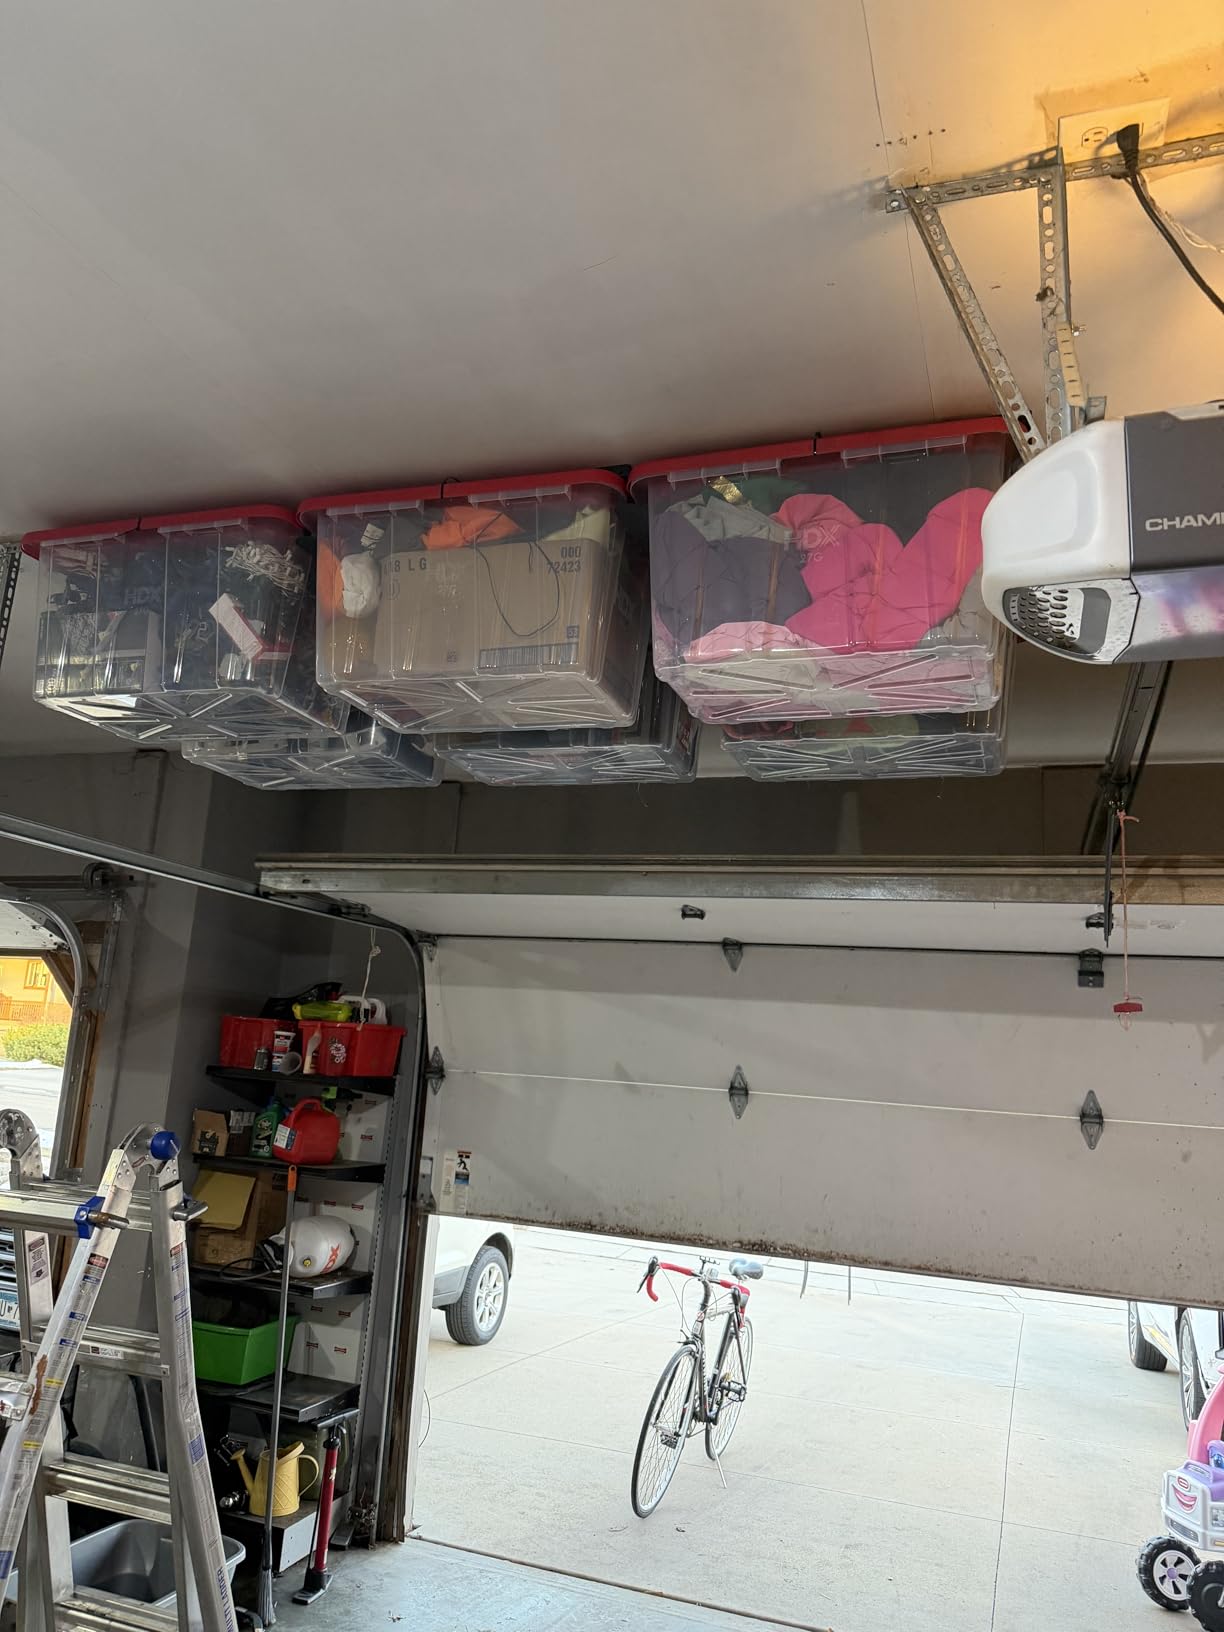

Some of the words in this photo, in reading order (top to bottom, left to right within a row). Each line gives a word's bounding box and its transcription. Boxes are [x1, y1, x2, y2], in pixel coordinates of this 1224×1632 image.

[1145, 512, 1224, 531] CHAM
[784, 525, 841, 550] HDX
[217, 1566, 229, 1607] LADDER
